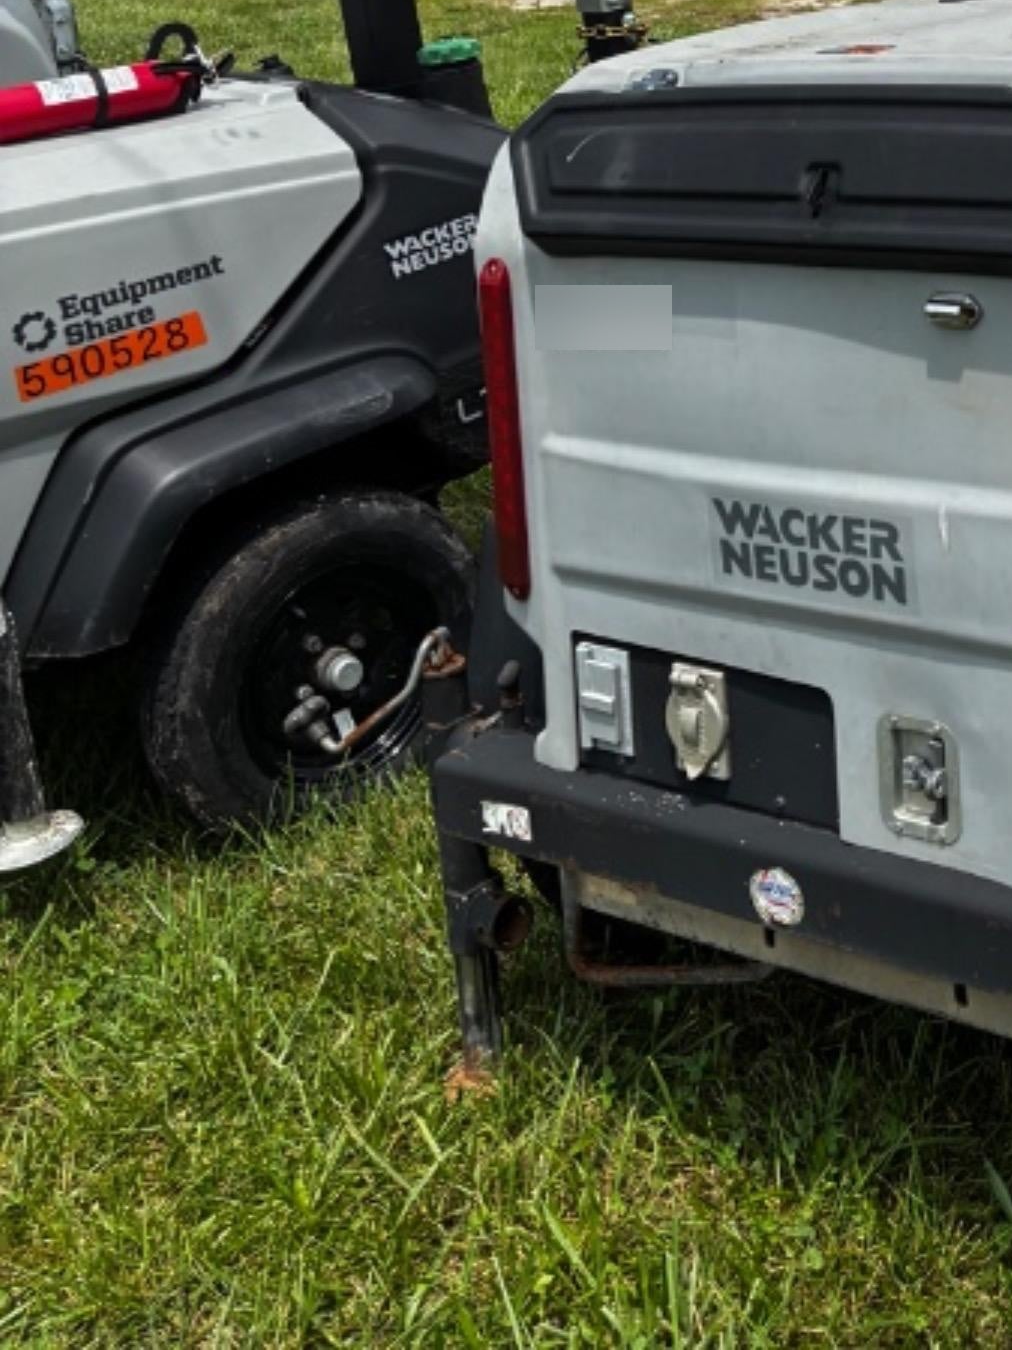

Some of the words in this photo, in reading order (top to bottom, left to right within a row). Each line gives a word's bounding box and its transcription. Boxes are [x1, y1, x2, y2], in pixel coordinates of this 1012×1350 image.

[383, 214, 479, 259] WACKER
[57, 254, 225, 321] Equipment
[22, 317, 189, 398] 590528
[64, 305, 156, 346] Share
[712, 497, 904, 562] WACKER
[719, 539, 907, 606] NEUSON
